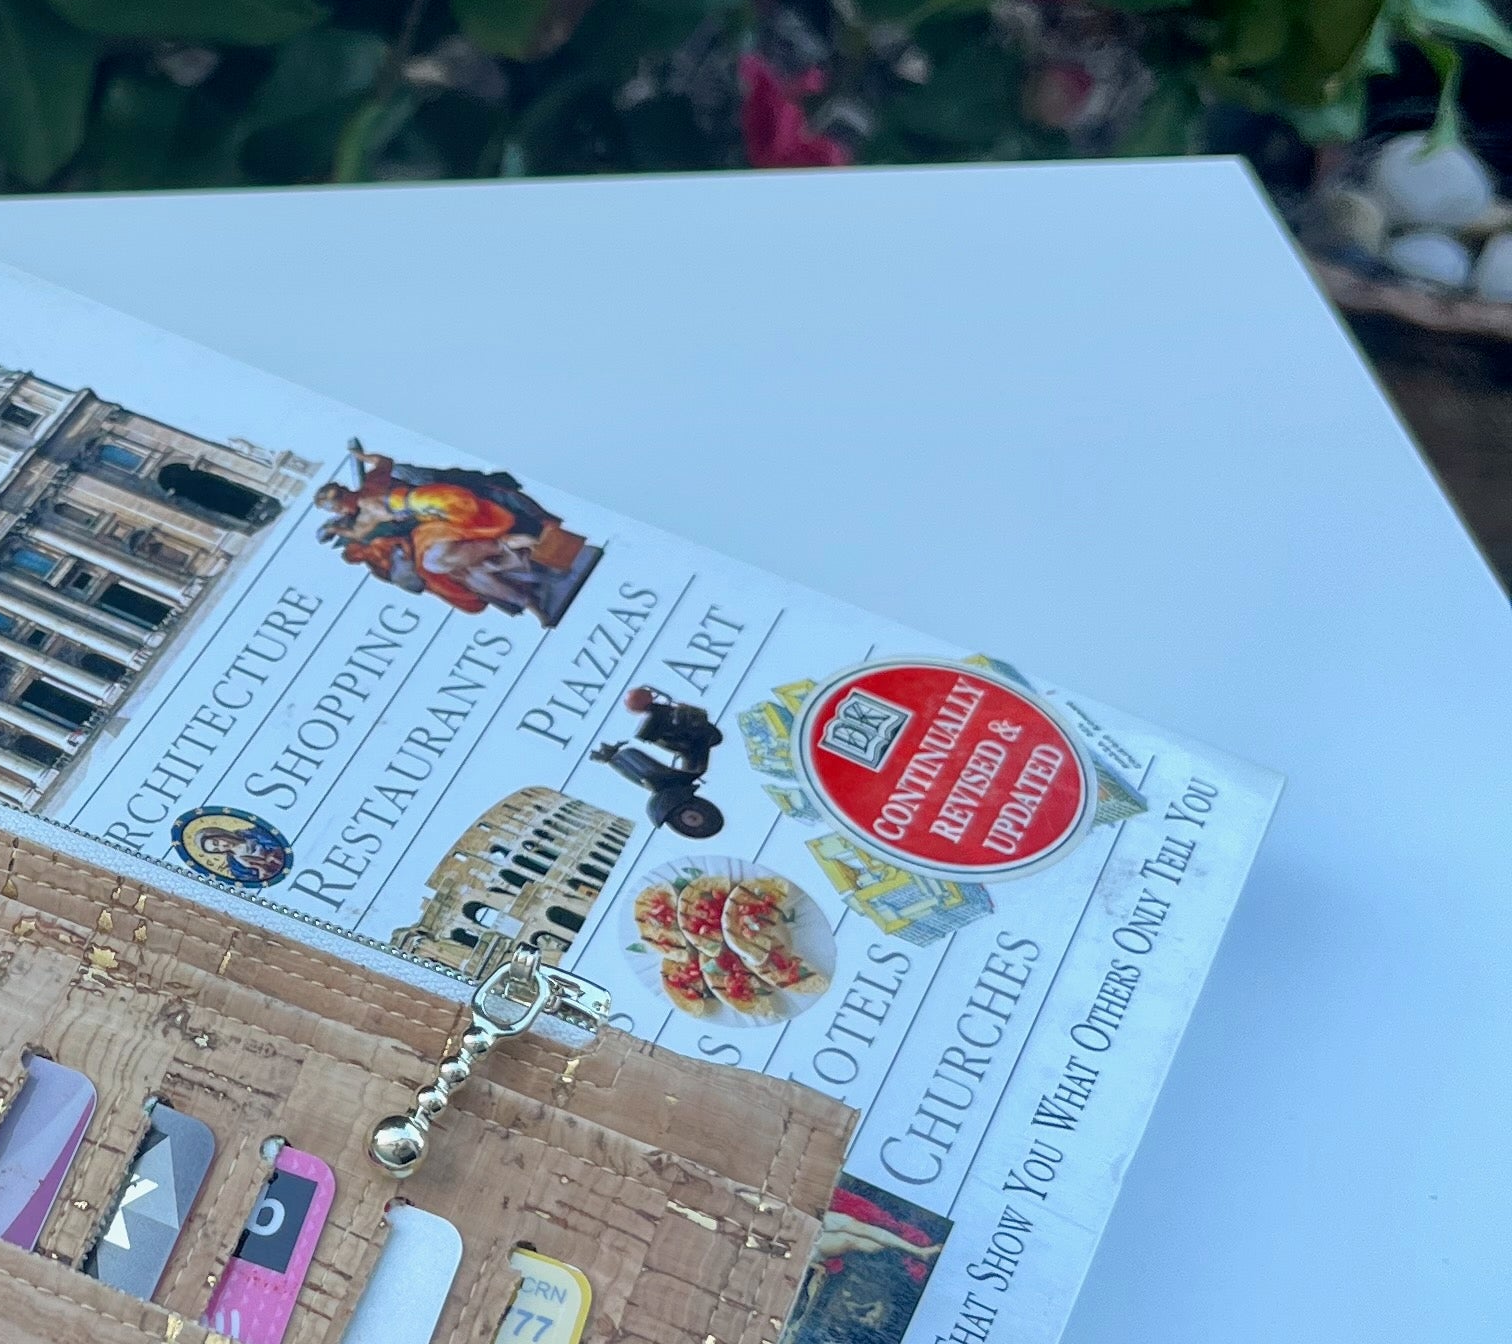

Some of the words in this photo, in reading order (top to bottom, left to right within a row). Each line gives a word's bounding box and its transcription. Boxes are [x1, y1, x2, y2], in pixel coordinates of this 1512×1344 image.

[517, 580, 659, 750] PIAZZAS
[662, 603, 745, 696] ART
[245, 604, 421, 810] SHOPPING
[289, 628, 513, 913] RESTAURANTS
[872, 675, 985, 841] CONTINUALLY
[929, 739, 1007, 844] REVISED
[987, 718, 1023, 743] &
[982, 743, 1065, 855] UPDATED
[1164, 777, 1220, 829] YOU
[1140, 836, 1197, 887] TELL
[1113, 888, 1172, 956] ONLY
[789, 943, 911, 1102] OTELS
[1070, 959, 1142, 1053] OTHERS
[880, 930, 1041, 1186] CHURCHES
[1031, 1055, 1100, 1132] WHAT
[1002, 1139, 1064, 1201] YOU
[521, 1277, 568, 1304] CRN
[966, 1205, 1034, 1292] SHOW
